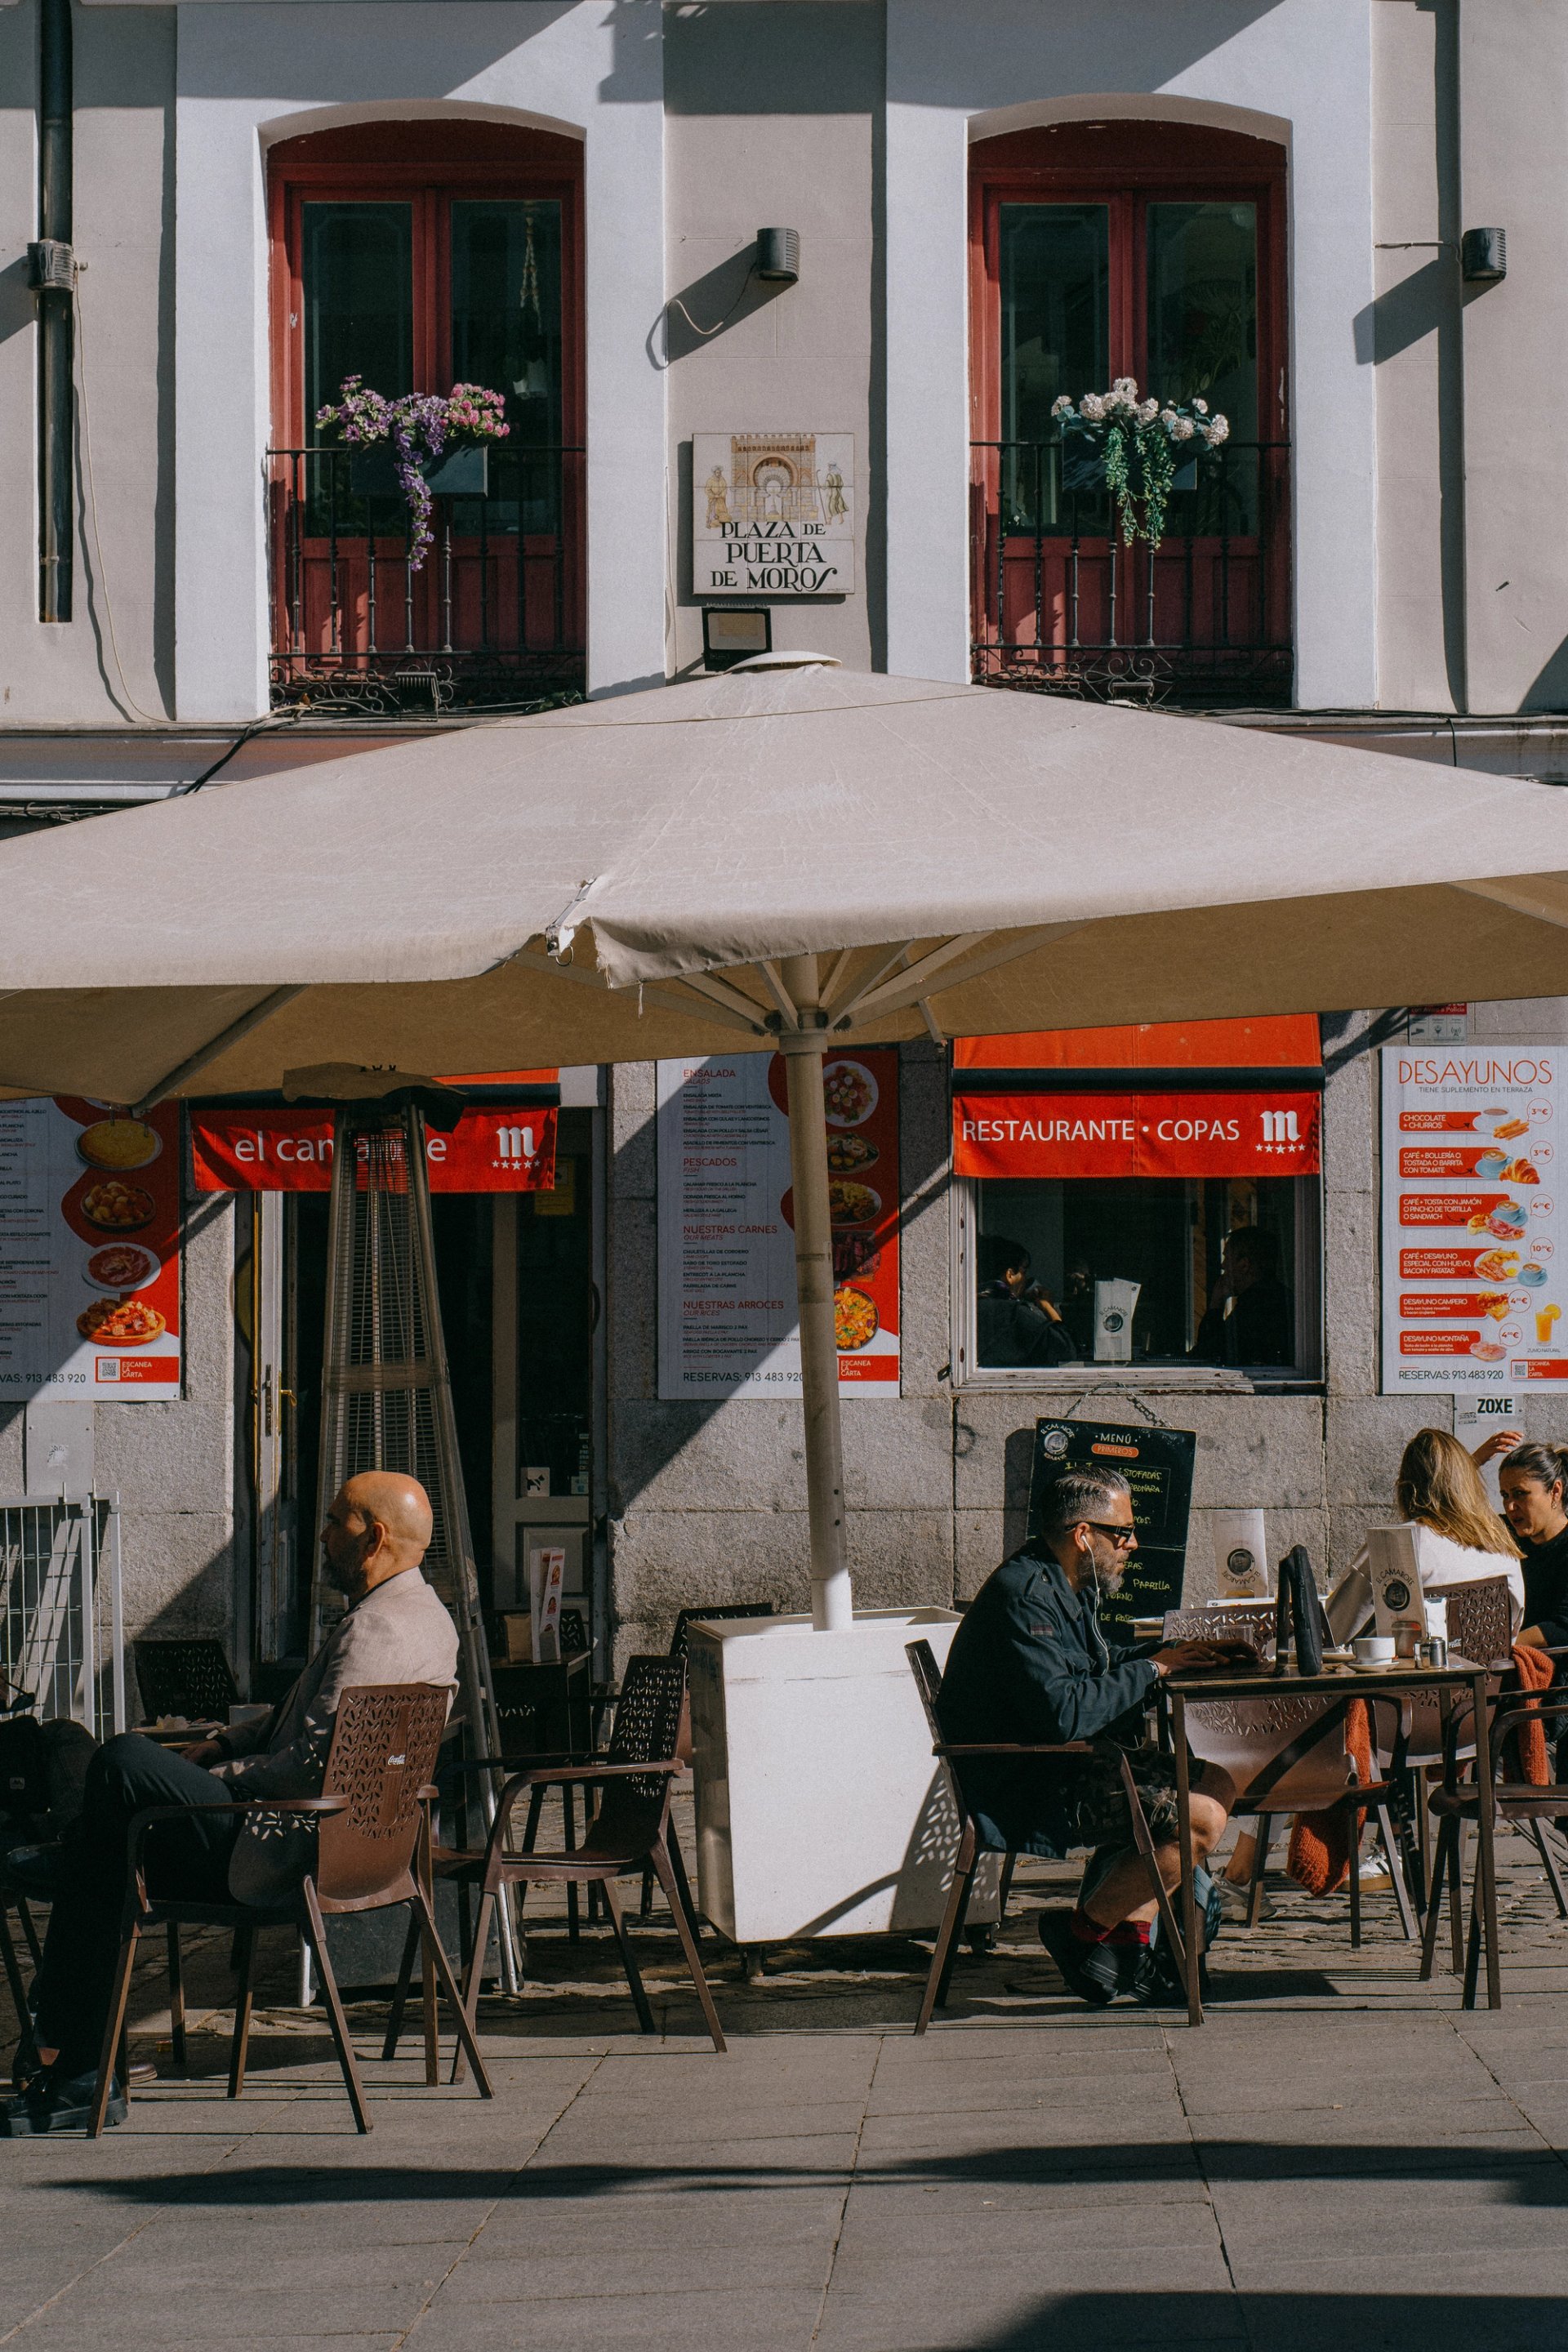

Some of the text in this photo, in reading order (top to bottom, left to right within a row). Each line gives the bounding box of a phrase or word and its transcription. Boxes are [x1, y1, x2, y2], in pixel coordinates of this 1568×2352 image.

[719, 521, 826, 538] PLAZA DE
[725, 542, 827, 567] PUERTA
[710, 567, 837, 592] DE MOROS
[684, 1069, 736, 1078] ENSALADA
[1399, 1060, 1552, 1085] DESAYUNOS
[962, 1120, 1240, 1142] RESTAURANTE COPAS
[234, 1130, 263, 1161] el
[684, 1158, 737, 1166] PESCADOS
[1459, 1197, 1481, 1205] JAMÓN
[684, 1225, 777, 1234] NUESTRAS CARNES
[684, 1300, 784, 1309] NUESTRAS ARROCES
[0, 1374, 86, 1383] VAS: 913 483 920
[684, 1373, 742, 1382] RESERVAS:
[745, 1373, 761, 1381] 913
[764, 1373, 783, 1381] 483
[1399, 1370, 1503, 1380] RESERVAS: 913 483 920
[1477, 1398, 1512, 1414] ZOXE
[1100, 1432, 1131, 1444] MENÚ
[1098, 1446, 1133, 1455] PRIMEROS
[1129, 1483, 1163, 1493] RBONARA.
[1380, 1568, 1414, 1586] CAMAROTE
[1101, 1613, 1111, 1621] DE
